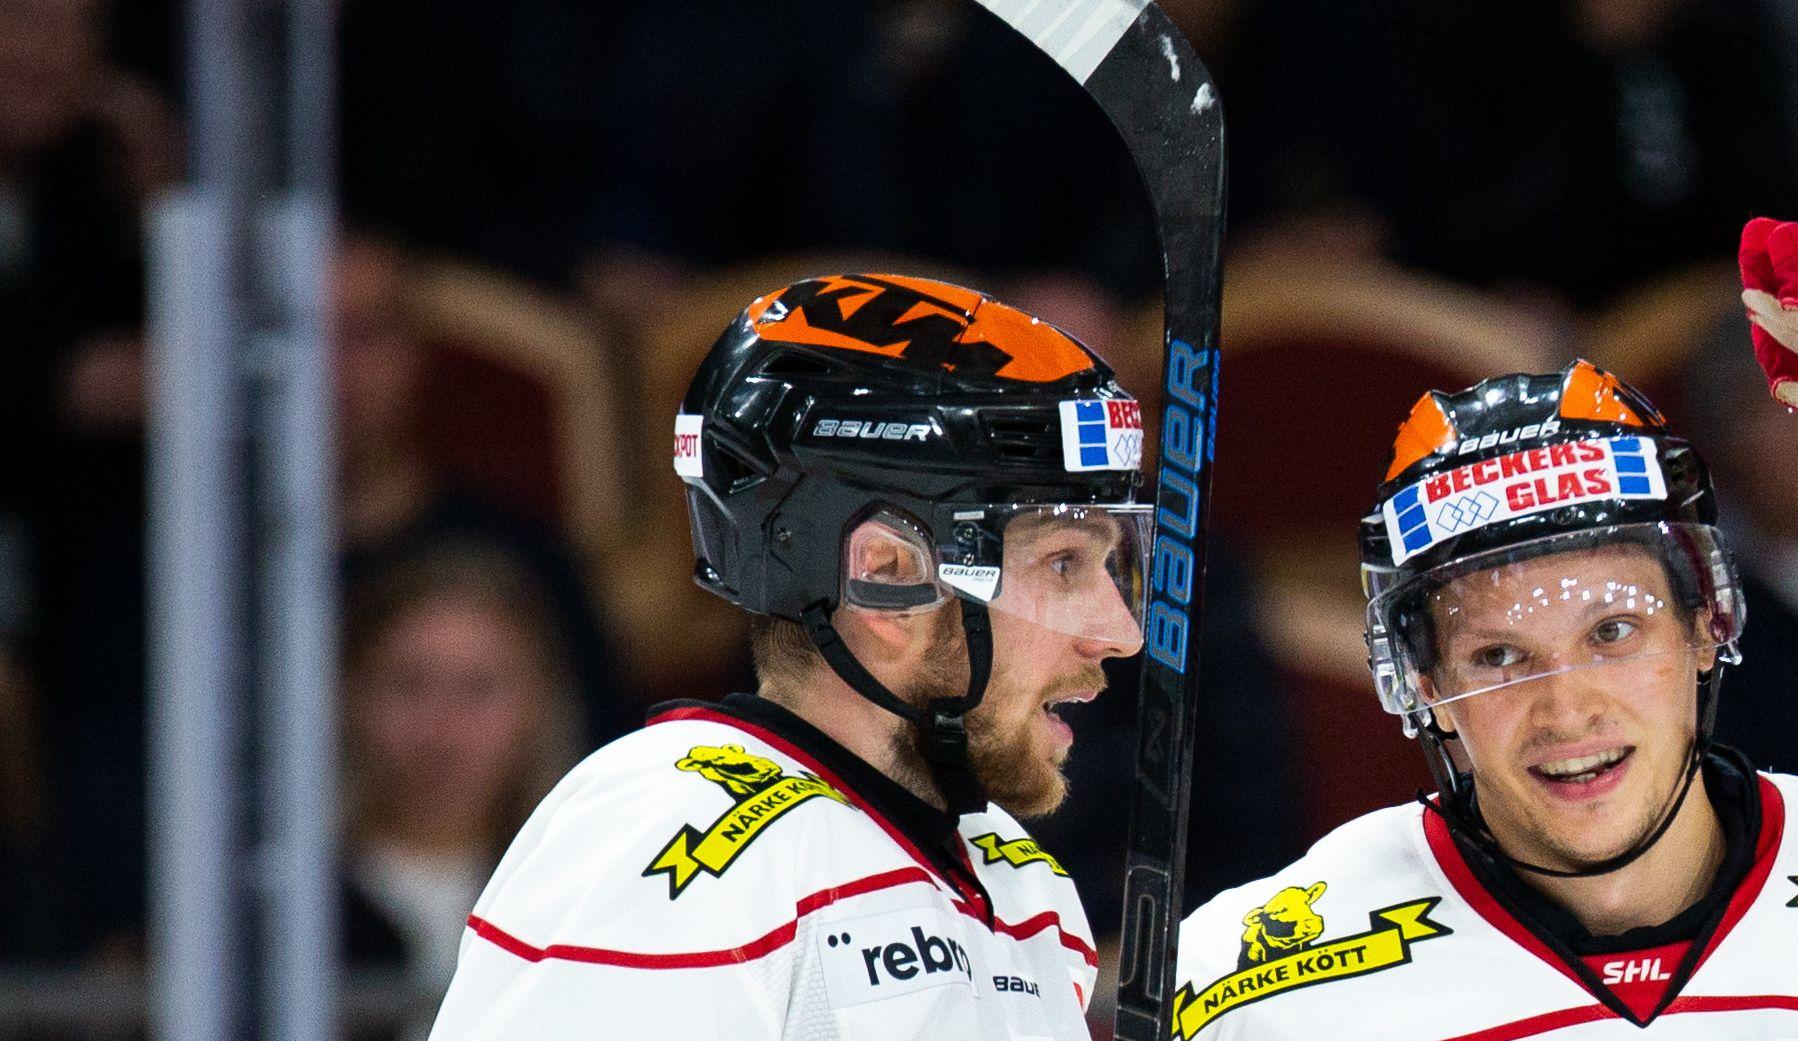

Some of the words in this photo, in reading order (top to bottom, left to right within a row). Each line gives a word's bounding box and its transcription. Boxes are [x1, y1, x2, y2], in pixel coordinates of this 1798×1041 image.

[813, 418, 933, 442] BAUER
[1459, 420, 1562, 455] BAUER
[1425, 439, 1606, 503] BECKERS
[1506, 468, 1611, 512] GLAS
[1148, 339, 1209, 674] BAUER
[721, 791, 791, 842] NÄRKE
[1204, 963, 1290, 1014] NÄRKE
[1296, 944, 1369, 977] KÖTT
[1602, 958, 1671, 985] SHL
